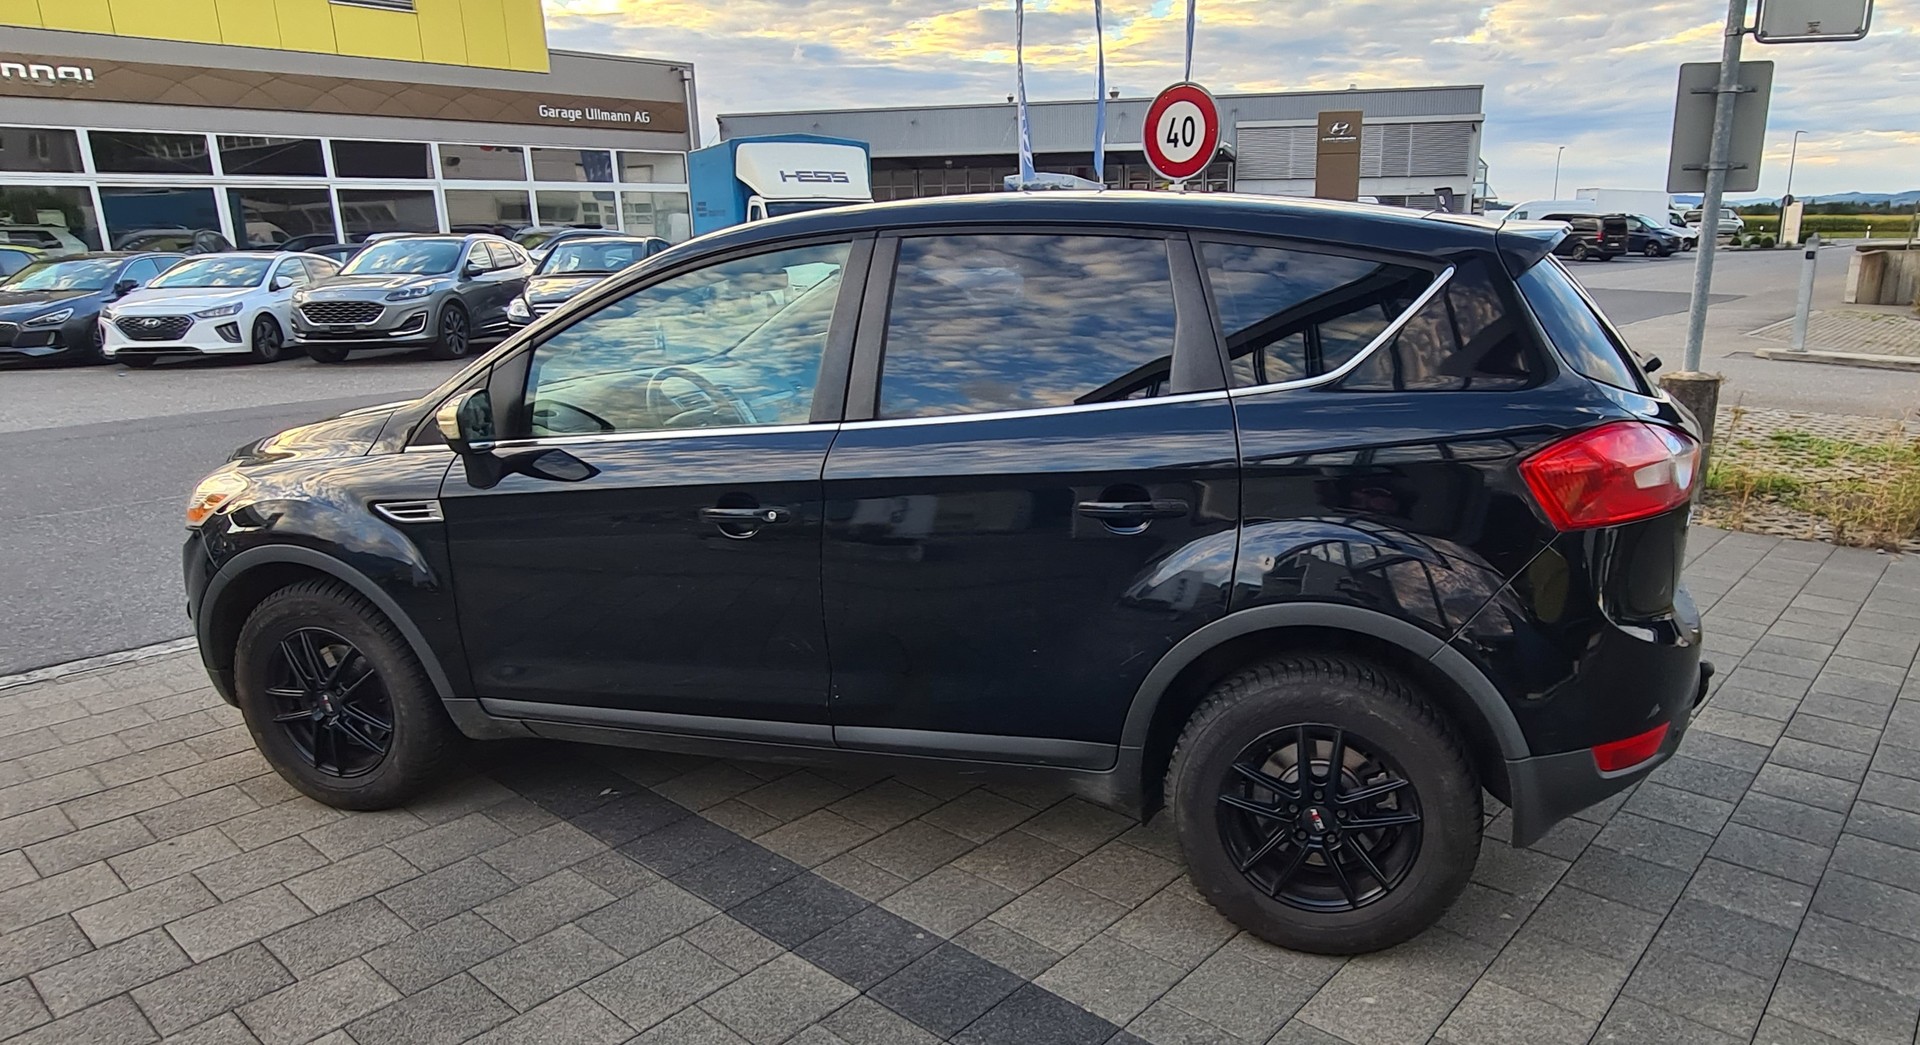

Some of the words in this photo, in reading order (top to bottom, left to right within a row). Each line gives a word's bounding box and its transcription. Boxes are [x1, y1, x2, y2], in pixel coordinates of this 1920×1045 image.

[539, 104, 583, 122] Garage
[585, 107, 632, 123] Ullmann
[633, 111, 651, 124] AG
[1166, 116, 1196, 148] 40
[779, 170, 850, 184] HESS
